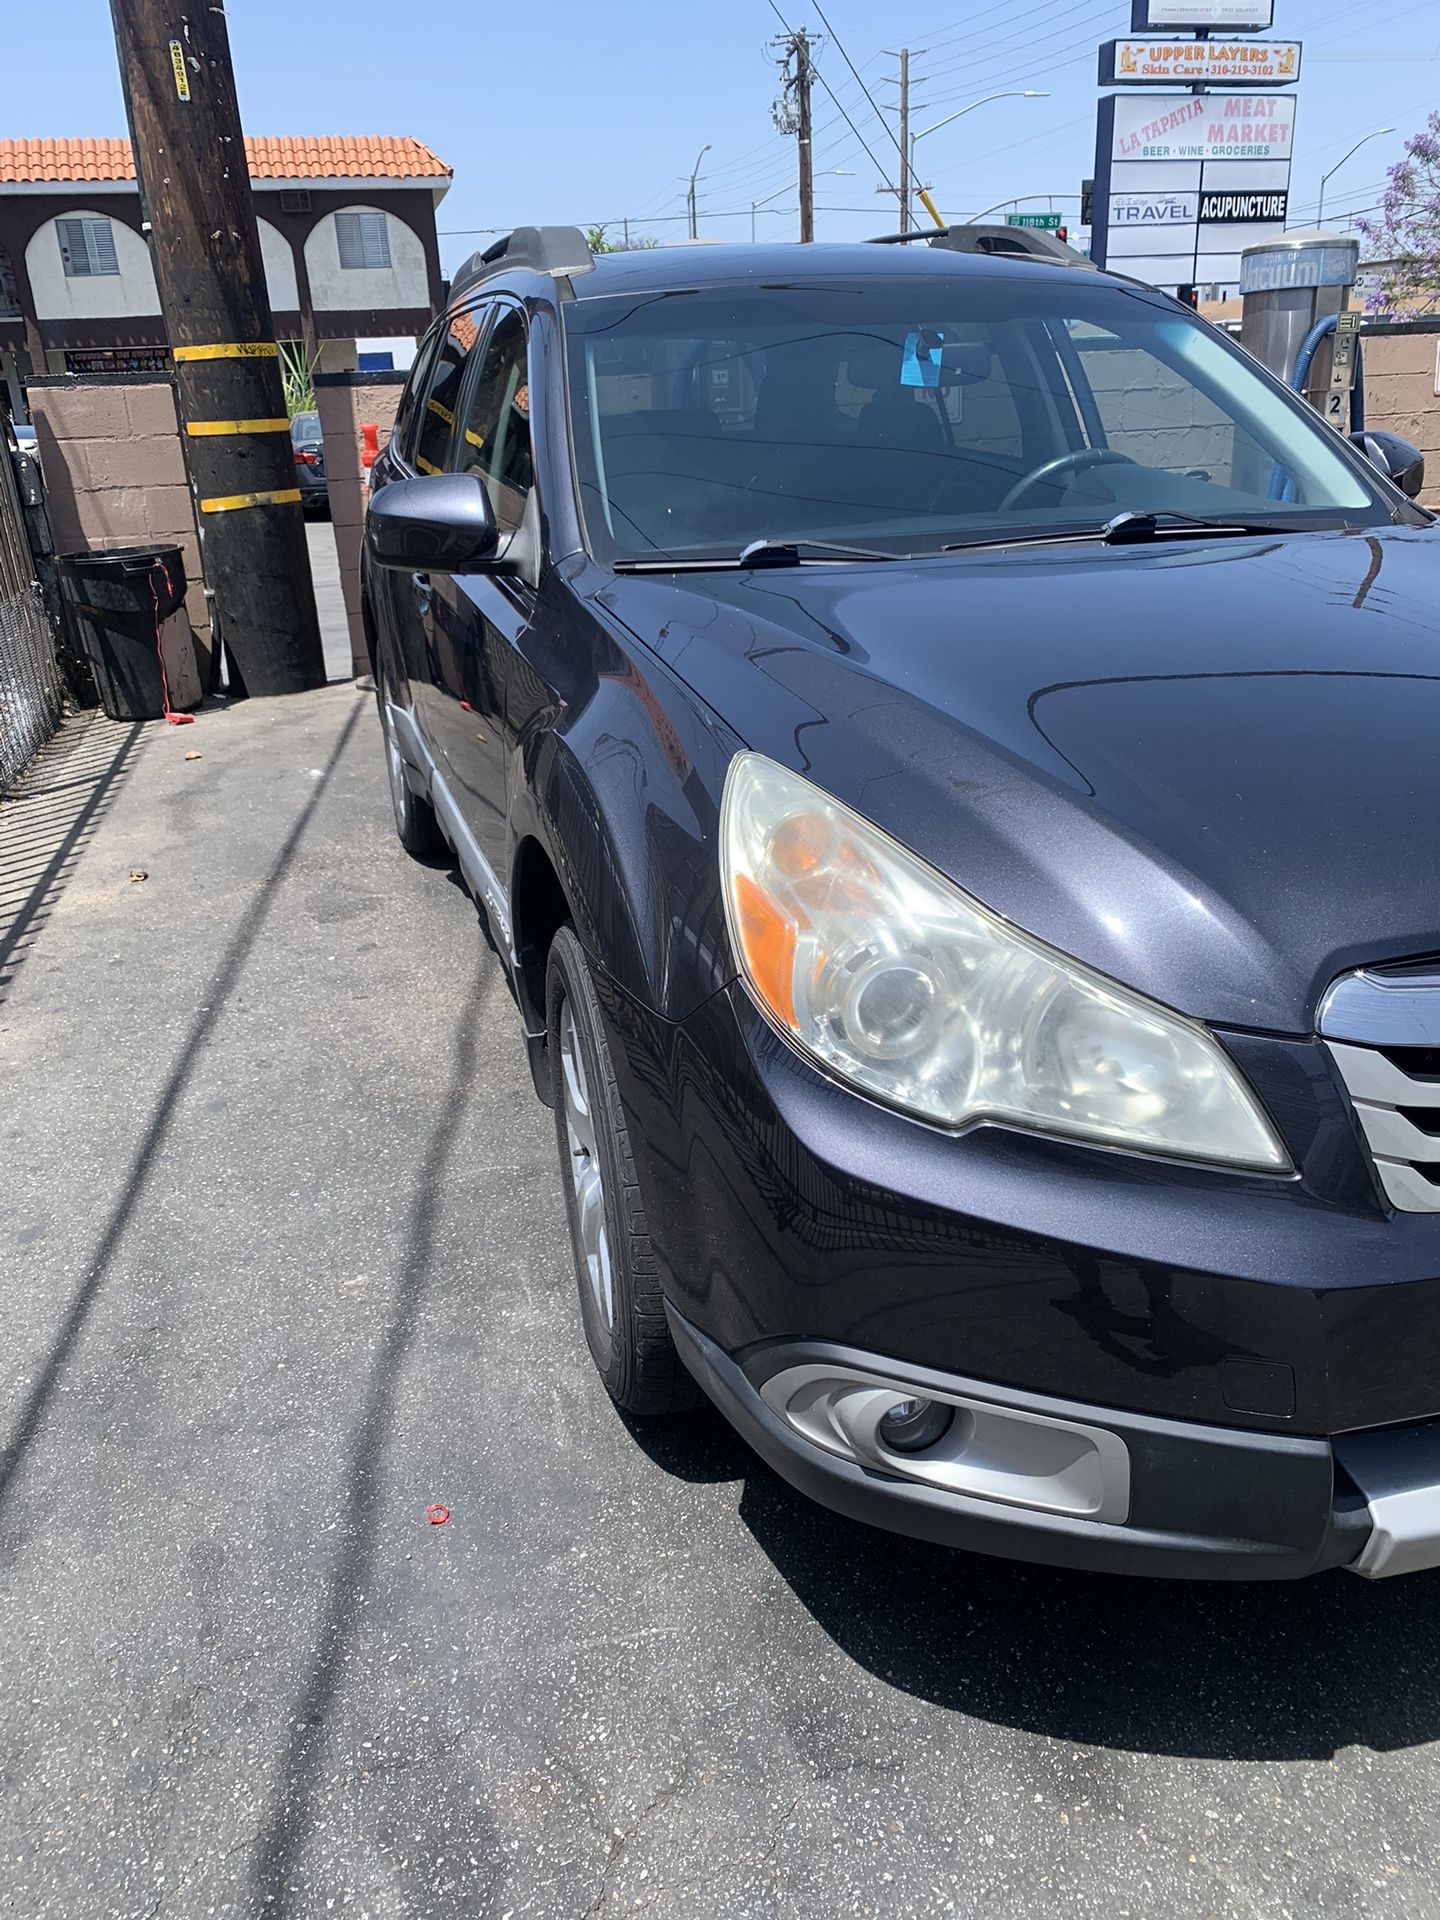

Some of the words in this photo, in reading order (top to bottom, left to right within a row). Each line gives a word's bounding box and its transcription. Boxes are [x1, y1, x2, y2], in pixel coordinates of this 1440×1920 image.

[1149, 46, 1205, 62] UPPER
[1208, 46, 1269, 63] LAYERS
[1142, 64, 1169, 75] Skin
[1173, 64, 1203, 75] Care
[1210, 65, 1273, 76] 310-219-3102
[1224, 98, 1277, 118] MEAT
[1119, 130, 1142, 154] LA
[1141, 99, 1205, 142] TAPATIA
[1207, 123, 1290, 143] MARKET
[1142, 146, 1170, 156] BEER
[1178, 146, 1204, 156] WINE
[1212, 145, 1270, 156] GROCERIES
[1112, 205, 1193, 220] TRAVEL
[1200, 195, 1285, 218] ACUPUNCTURE
[1048, 217, 1058, 227] St
[1330, 396, 1341, 414] 2
